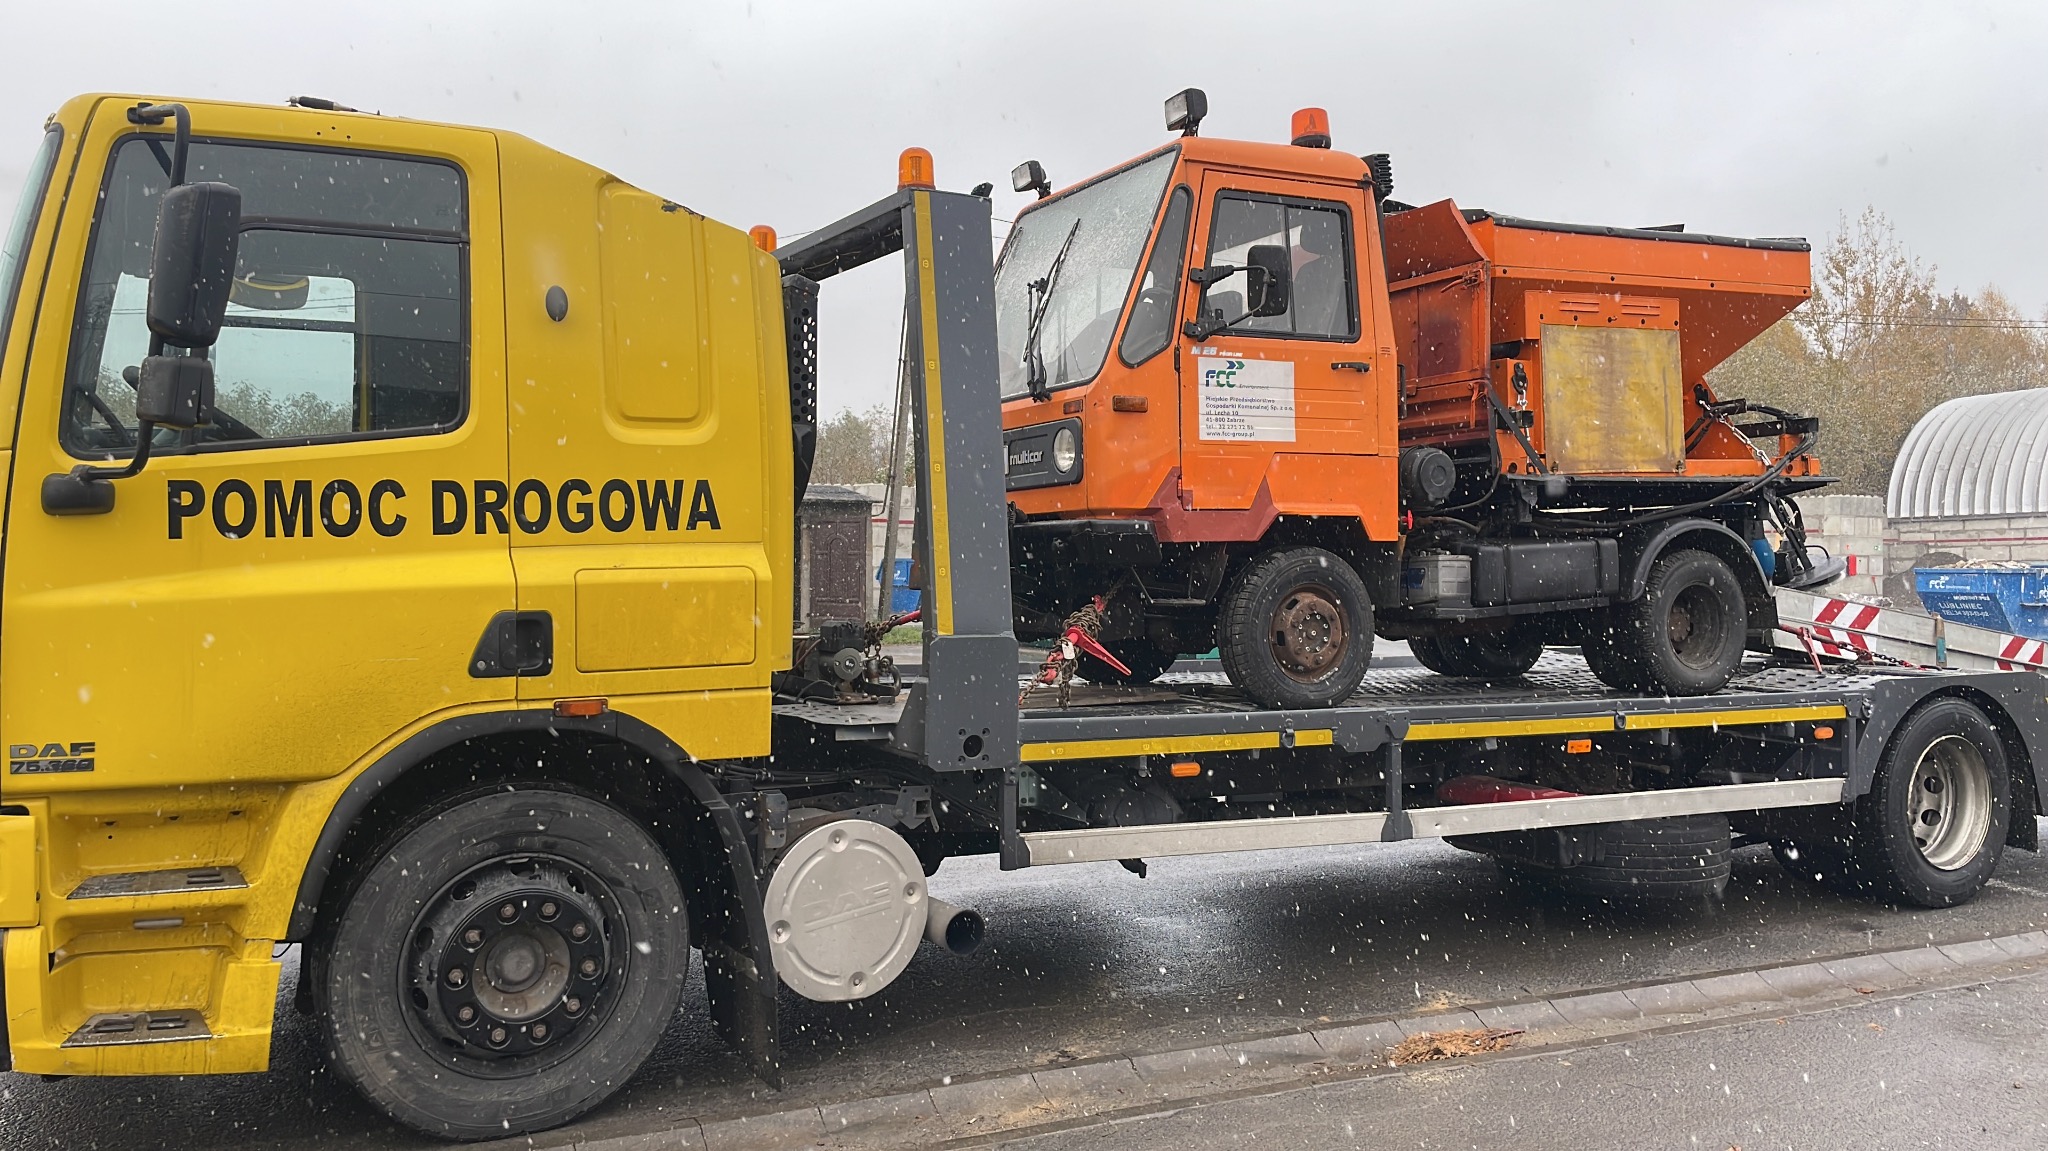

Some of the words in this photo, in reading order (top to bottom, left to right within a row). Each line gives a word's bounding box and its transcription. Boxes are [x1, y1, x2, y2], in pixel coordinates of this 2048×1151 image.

[1205, 370, 1236, 388] FCC
[1009, 450, 1043, 466] multicar
[166, 479, 407, 540] POMOC
[431, 479, 722, 536] DROGOWA
[1929, 580, 1945, 589] FCC
[9, 741, 96, 759] DAF
[801, 880, 891, 918] DAF
